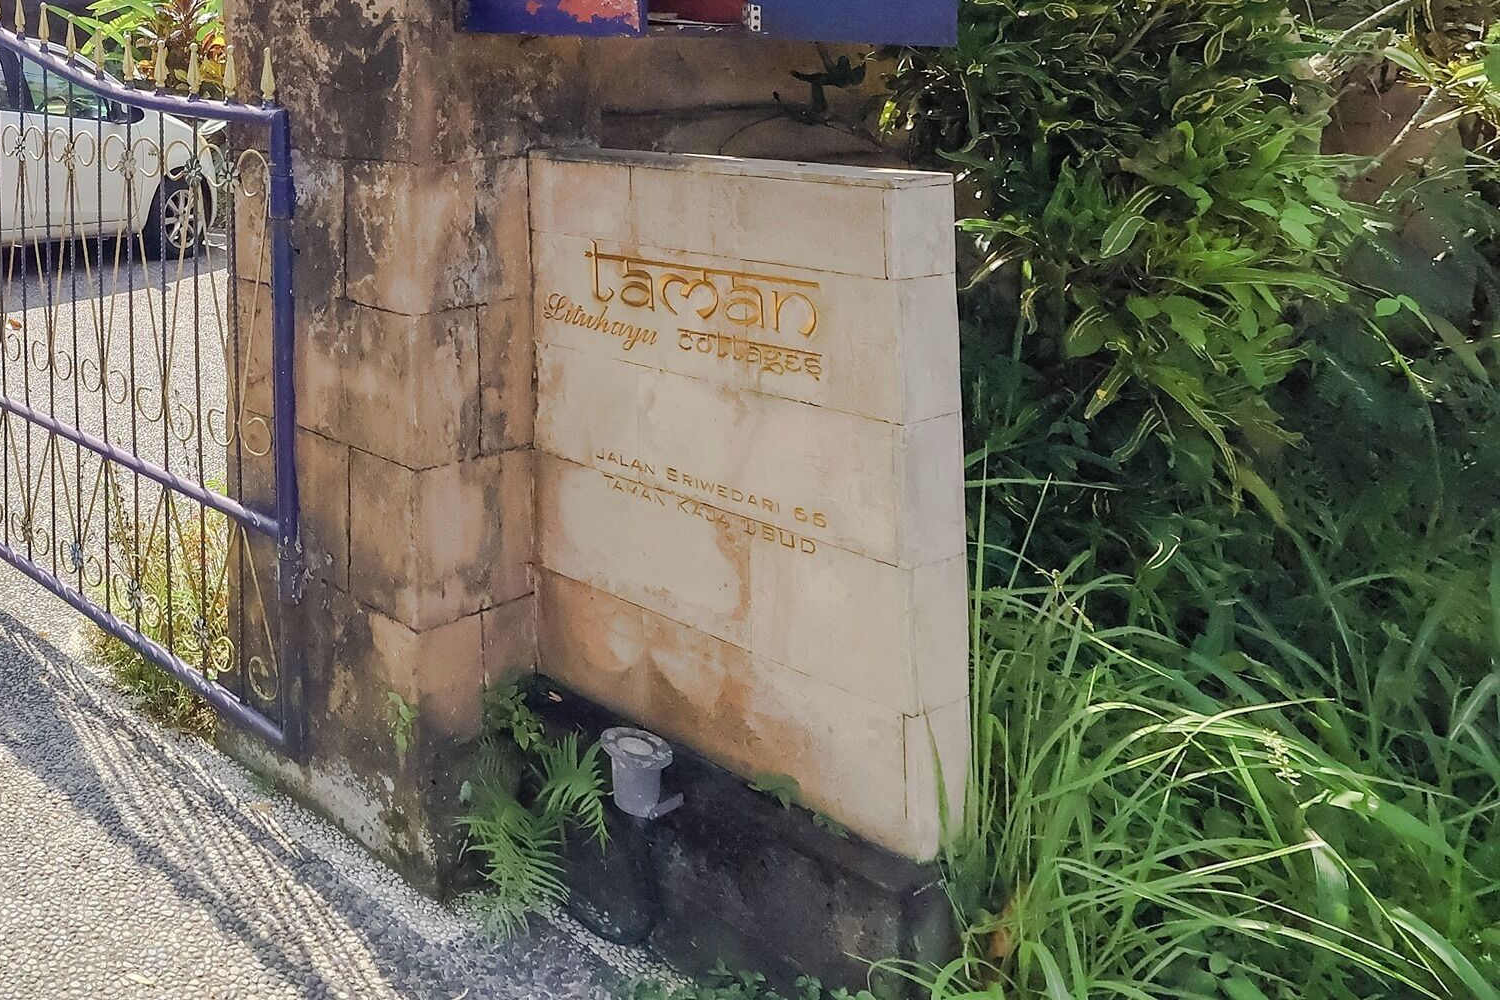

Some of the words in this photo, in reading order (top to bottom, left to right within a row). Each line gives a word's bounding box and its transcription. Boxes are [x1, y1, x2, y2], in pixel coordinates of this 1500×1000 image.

[596, 448, 656, 475] JALAN
[666, 467, 780, 513] SRIWEDARI
[793, 507, 828, 528] 66
[603, 474, 665, 506] TAMAN
[743, 518, 817, 554] UBUD
